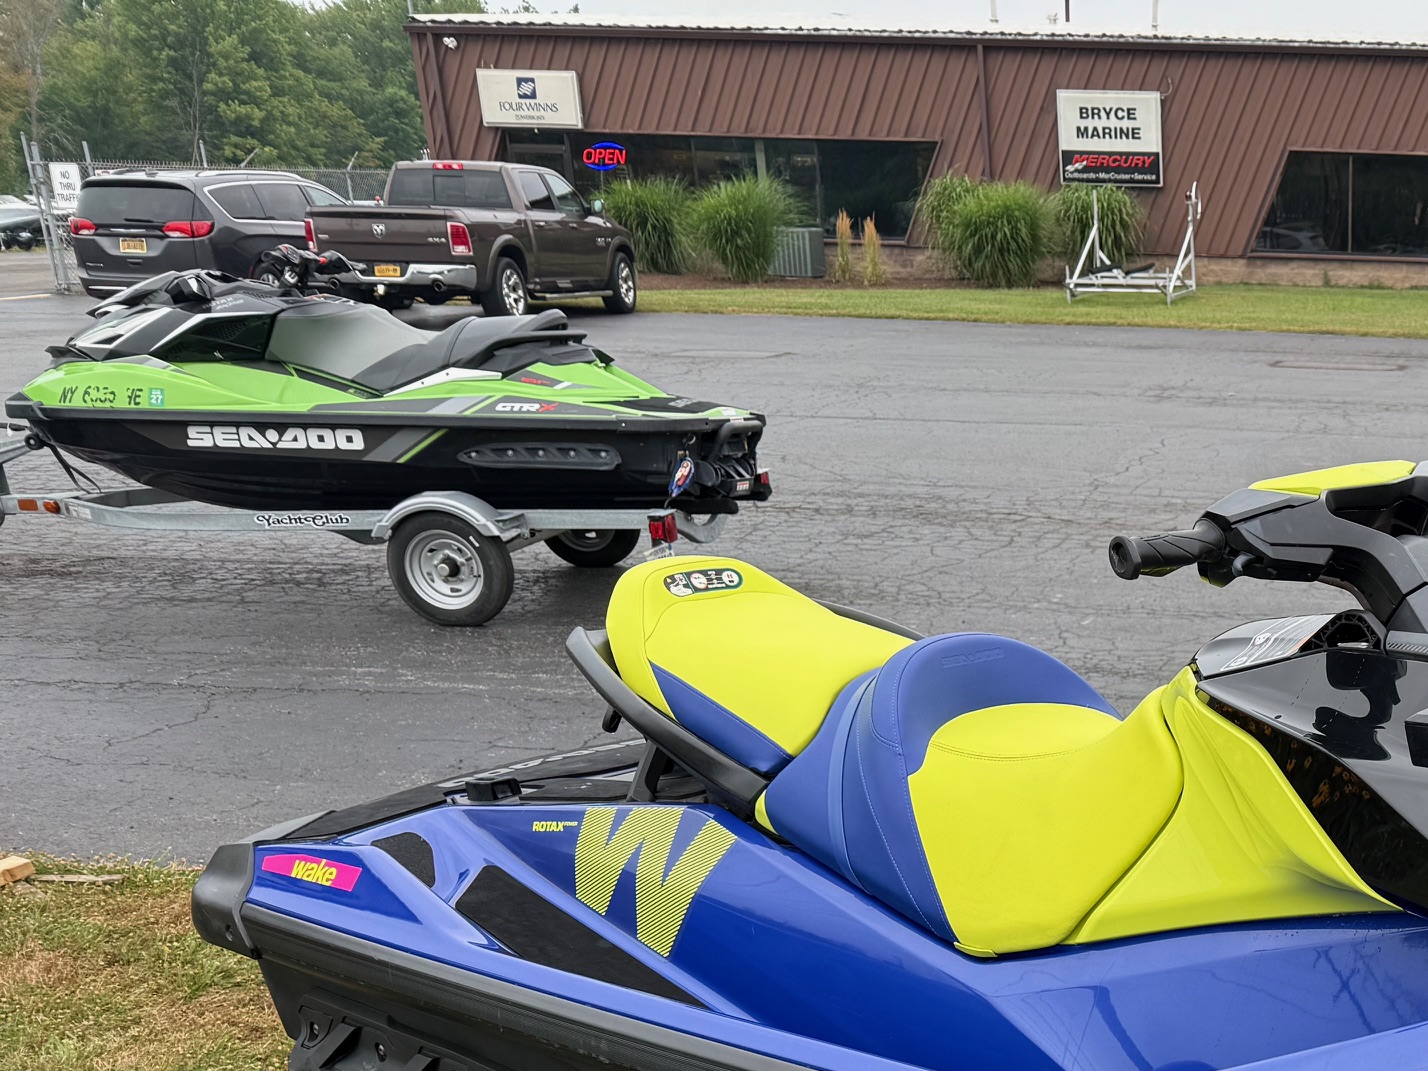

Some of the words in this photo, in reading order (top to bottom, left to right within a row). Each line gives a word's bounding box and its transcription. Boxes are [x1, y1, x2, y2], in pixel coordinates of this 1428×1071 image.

[499, 101, 525, 112] FOUR
[525, 101, 559, 113] WINNS
[1079, 106, 1137, 120] BRYCE
[1076, 126, 1142, 140] MARINE
[583, 148, 626, 165] OPEN
[1072, 154, 1155, 168] MERCURY
[60, 170, 70, 180] NO
[59, 182, 76, 191] THRU
[59, 386, 78, 403] NY
[150, 395, 163, 404] 27
[532, 821, 564, 832] ROTAX
[291, 858, 338, 887] wake
